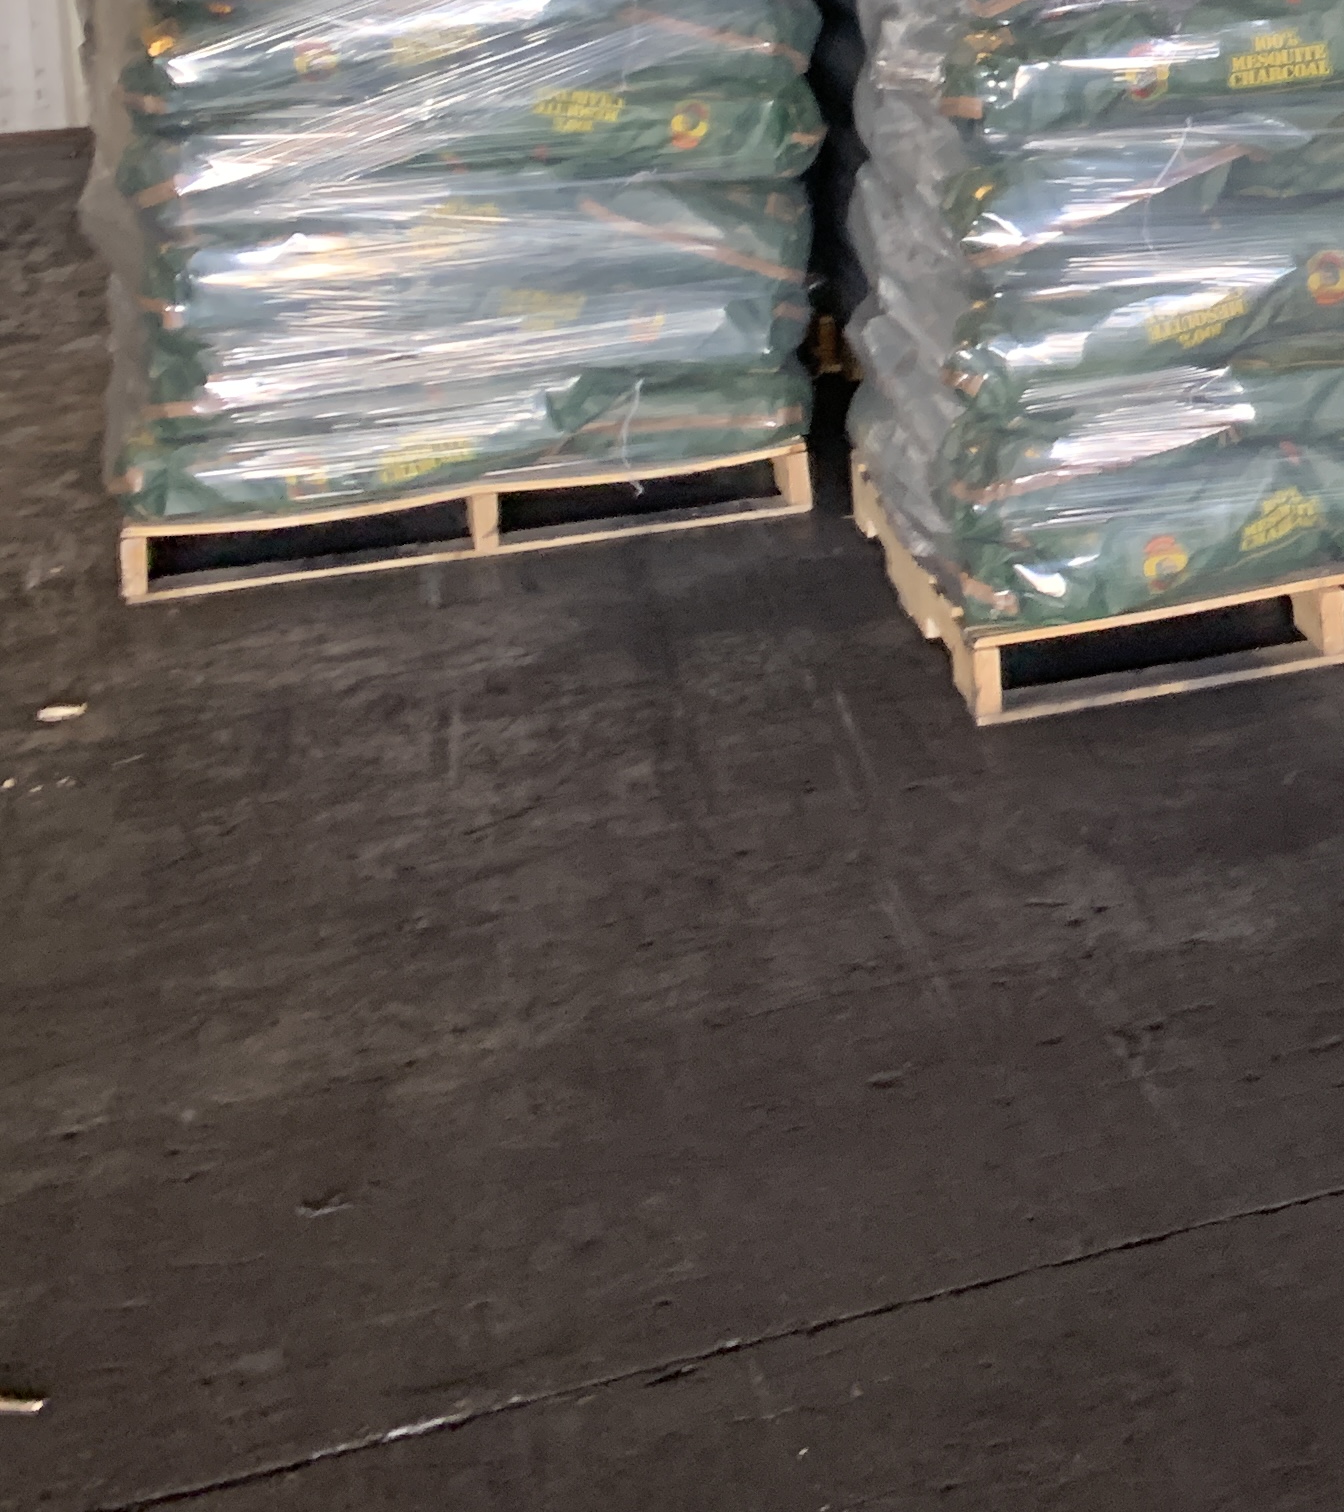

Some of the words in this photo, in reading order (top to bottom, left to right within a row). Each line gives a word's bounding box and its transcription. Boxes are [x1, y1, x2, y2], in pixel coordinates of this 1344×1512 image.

[1254, 31, 1301, 54] 100%
[1231, 44, 1329, 72] MESQUITE
[1229, 58, 1332, 88] CHARCOAL
